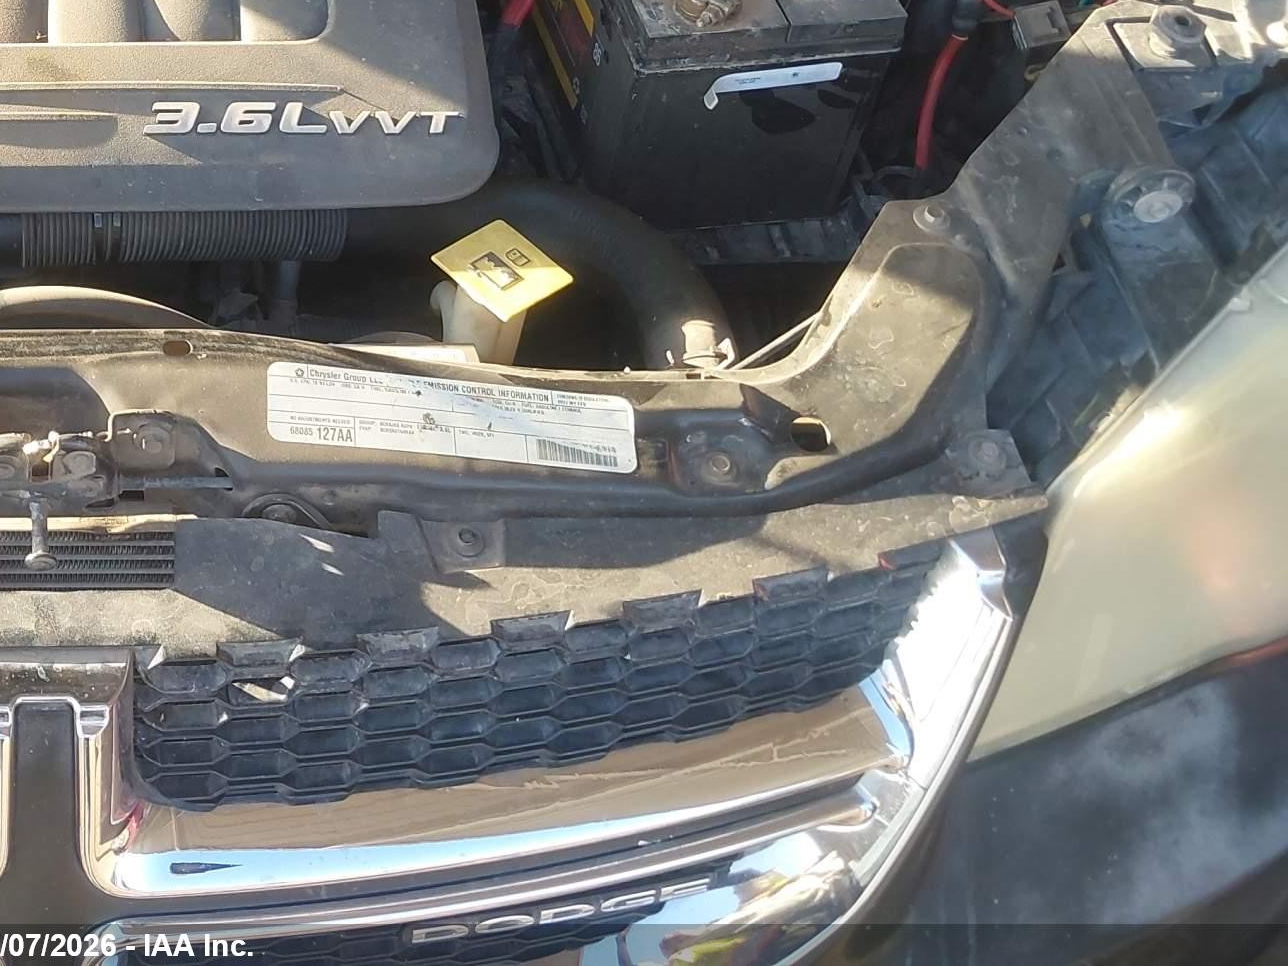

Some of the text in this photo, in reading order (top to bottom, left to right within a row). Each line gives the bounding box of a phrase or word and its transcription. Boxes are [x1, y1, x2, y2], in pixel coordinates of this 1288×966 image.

[309, 368, 341, 380] Chrysler
[343, 372, 367, 383] Group
[461, 385, 496, 397] CONTROL
[498, 389, 550, 403] INFORMATION
[289, 425, 353, 443] 68085 127AA
